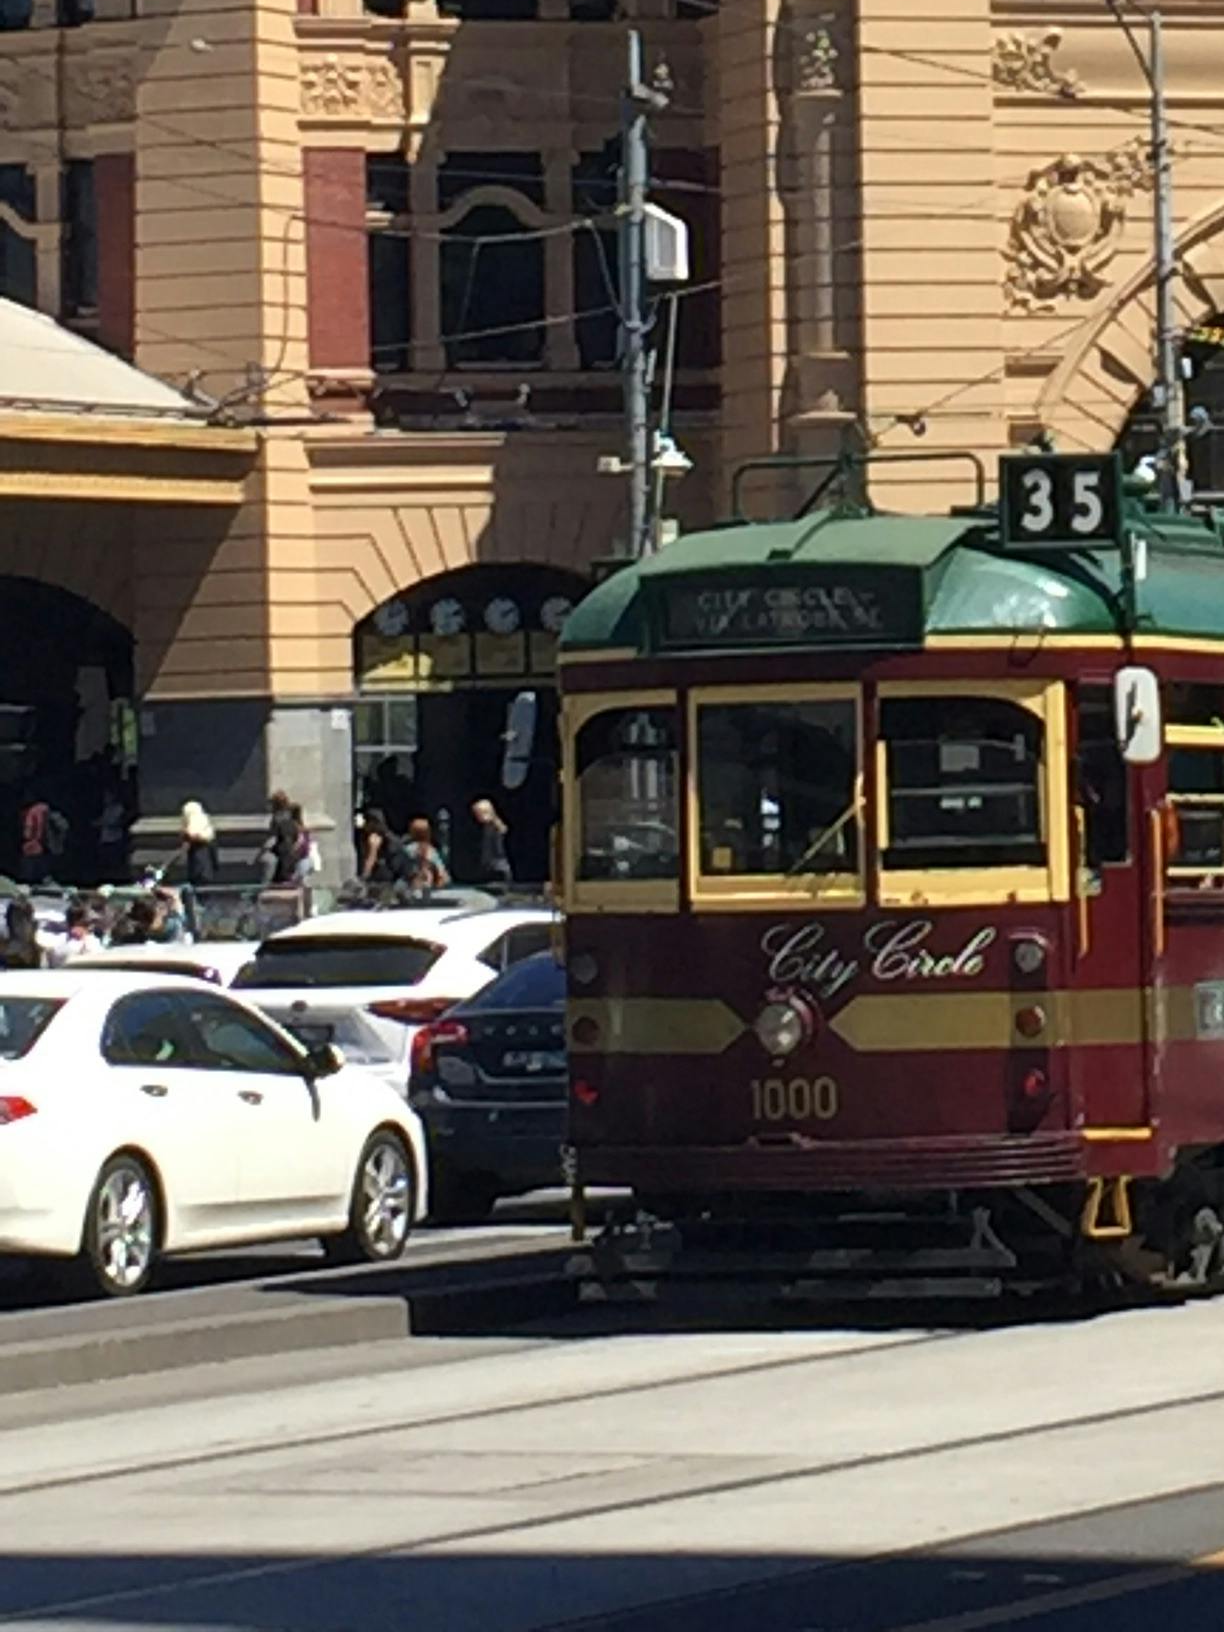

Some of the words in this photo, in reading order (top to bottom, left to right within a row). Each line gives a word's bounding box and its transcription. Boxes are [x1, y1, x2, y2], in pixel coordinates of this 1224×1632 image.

[1021, 467, 1103, 533] 35
[760, 921, 859, 999] City
[864, 919, 998, 981] Circle
[749, 1076, 839, 1121] 1000
